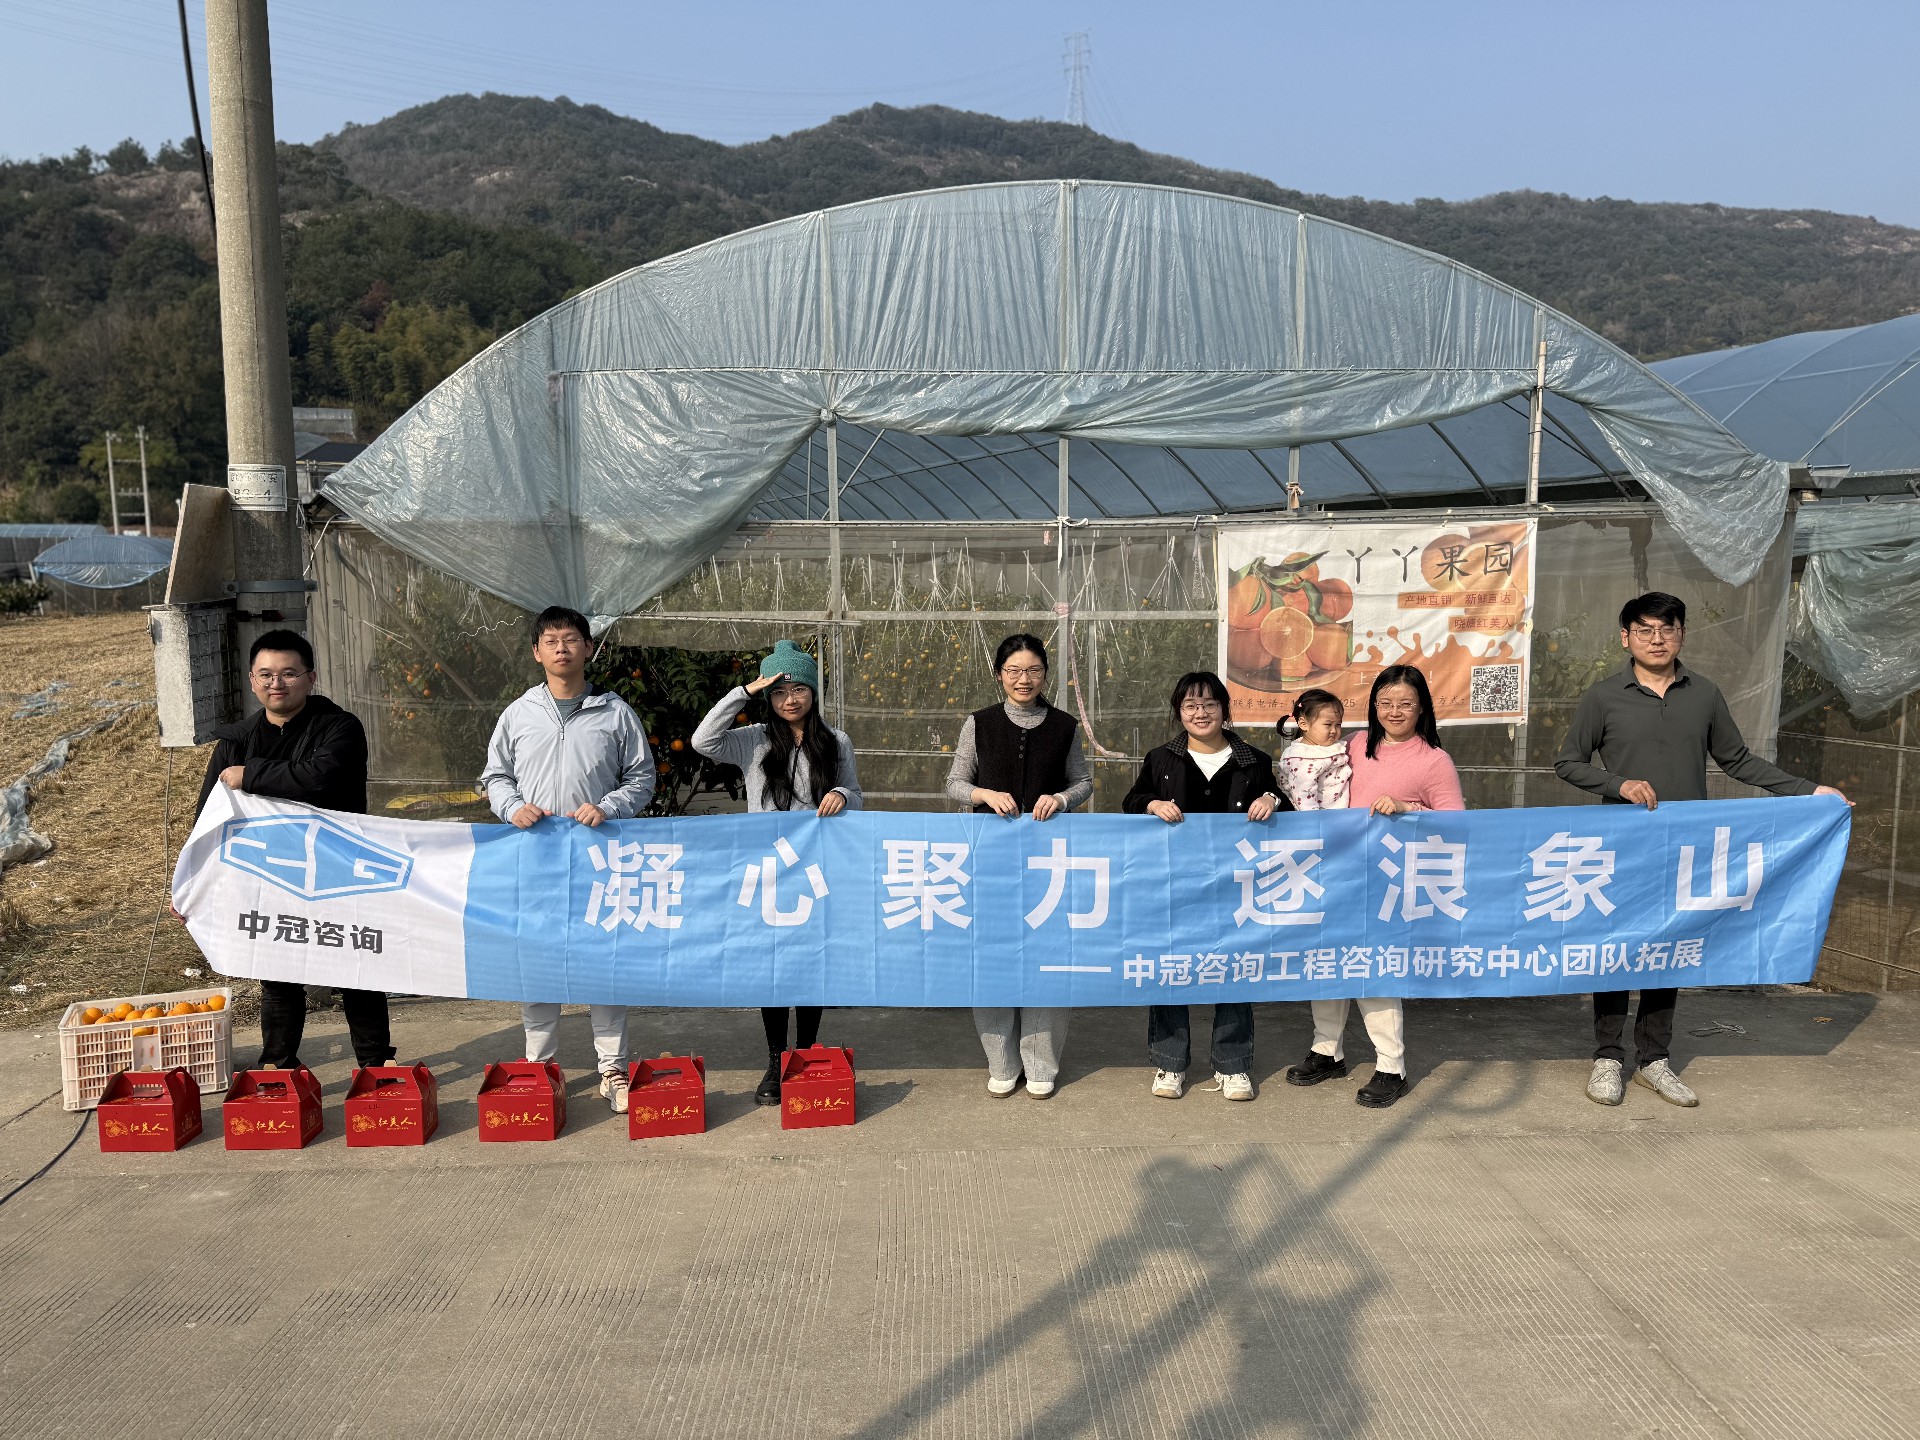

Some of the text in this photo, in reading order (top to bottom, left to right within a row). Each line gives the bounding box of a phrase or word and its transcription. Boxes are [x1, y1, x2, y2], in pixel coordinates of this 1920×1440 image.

[1346, 541, 1514, 584] 丫丫果园
[1404, 593, 1511, 606] 产地直销 新鲜直达
[584, 826, 1764, 932] 凝心聚力 逐浪象山
[237, 910, 383, 954] 中冠咨询
